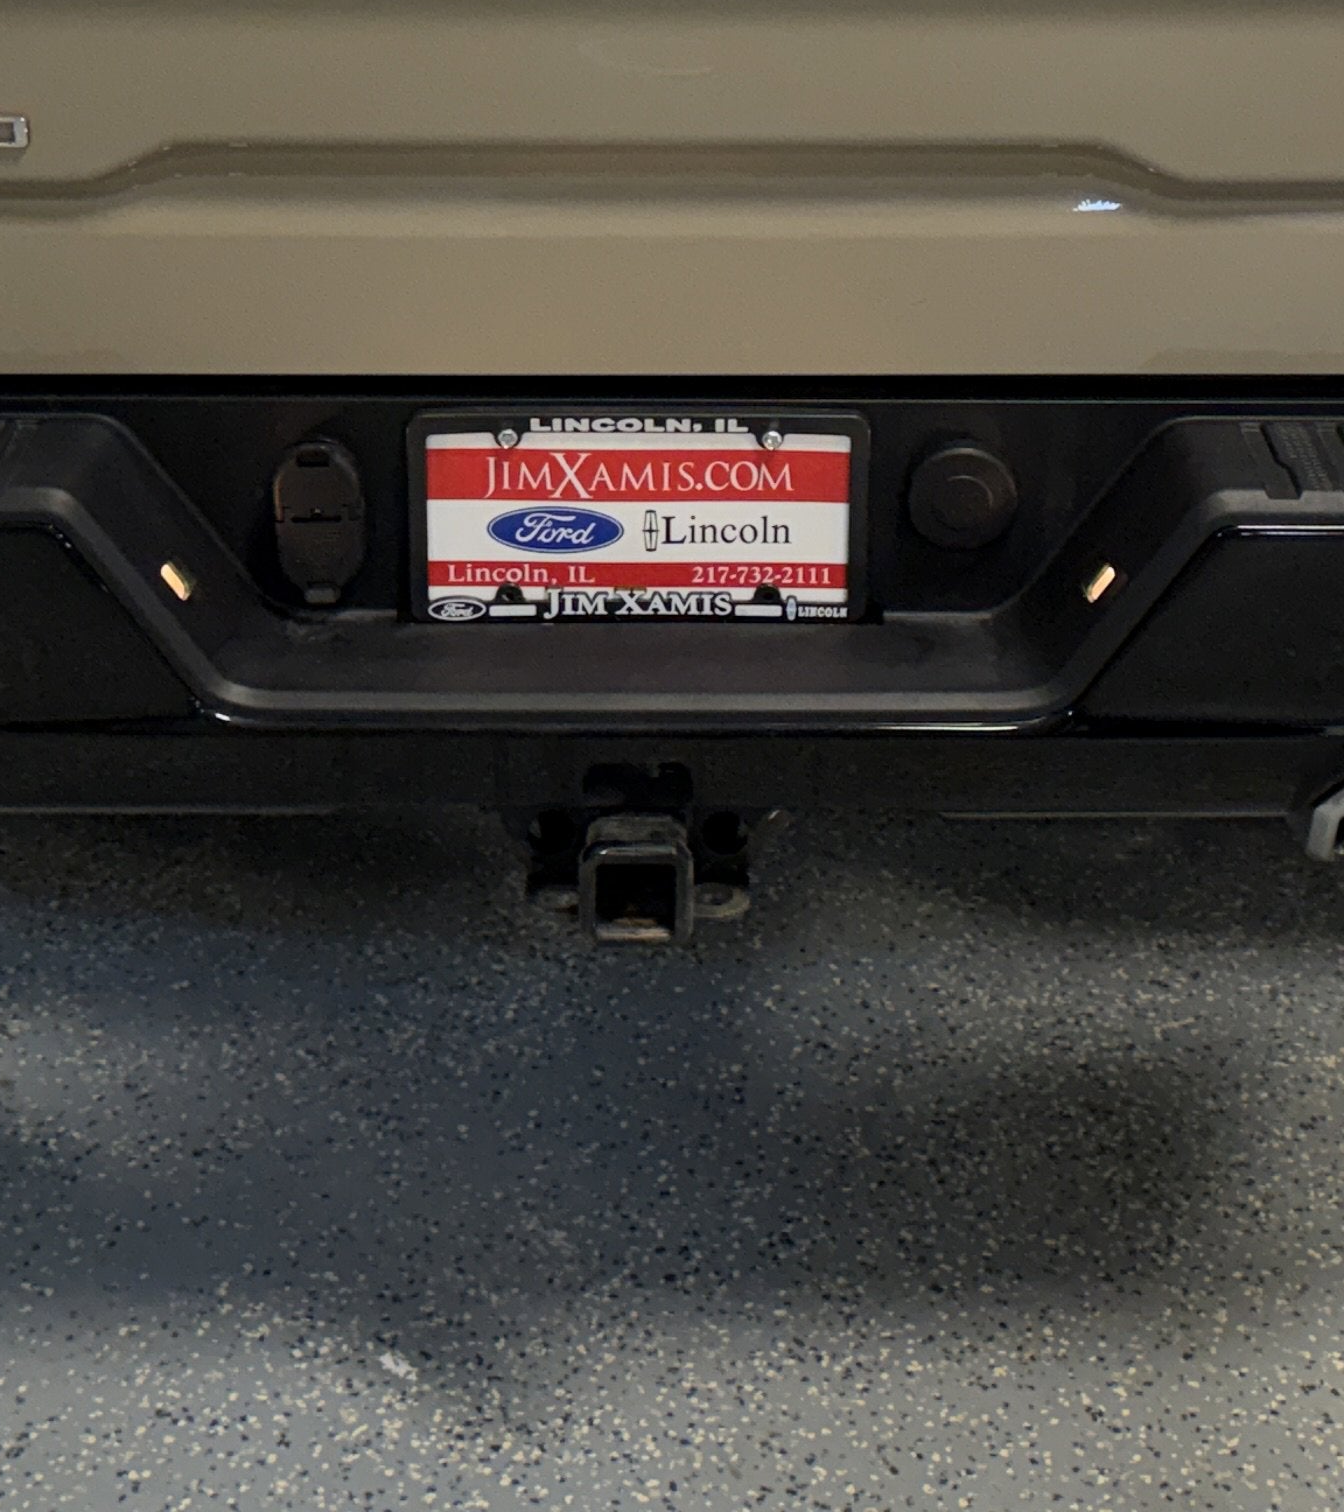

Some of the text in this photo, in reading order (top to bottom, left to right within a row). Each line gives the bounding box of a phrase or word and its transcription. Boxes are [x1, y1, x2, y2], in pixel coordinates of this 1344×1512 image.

[530, 417, 750, 434] LINCOLN, IL
[515, 511, 594, 545] Ford
[660, 514, 792, 545] Lincoln
[447, 564, 596, 586] Lincoln, IL
[691, 565, 832, 585] 217-732-2111
[439, 602, 475, 618] Ford
[543, 587, 733, 619] JIM XAMIS
[797, 605, 848, 618] LINCOLN
